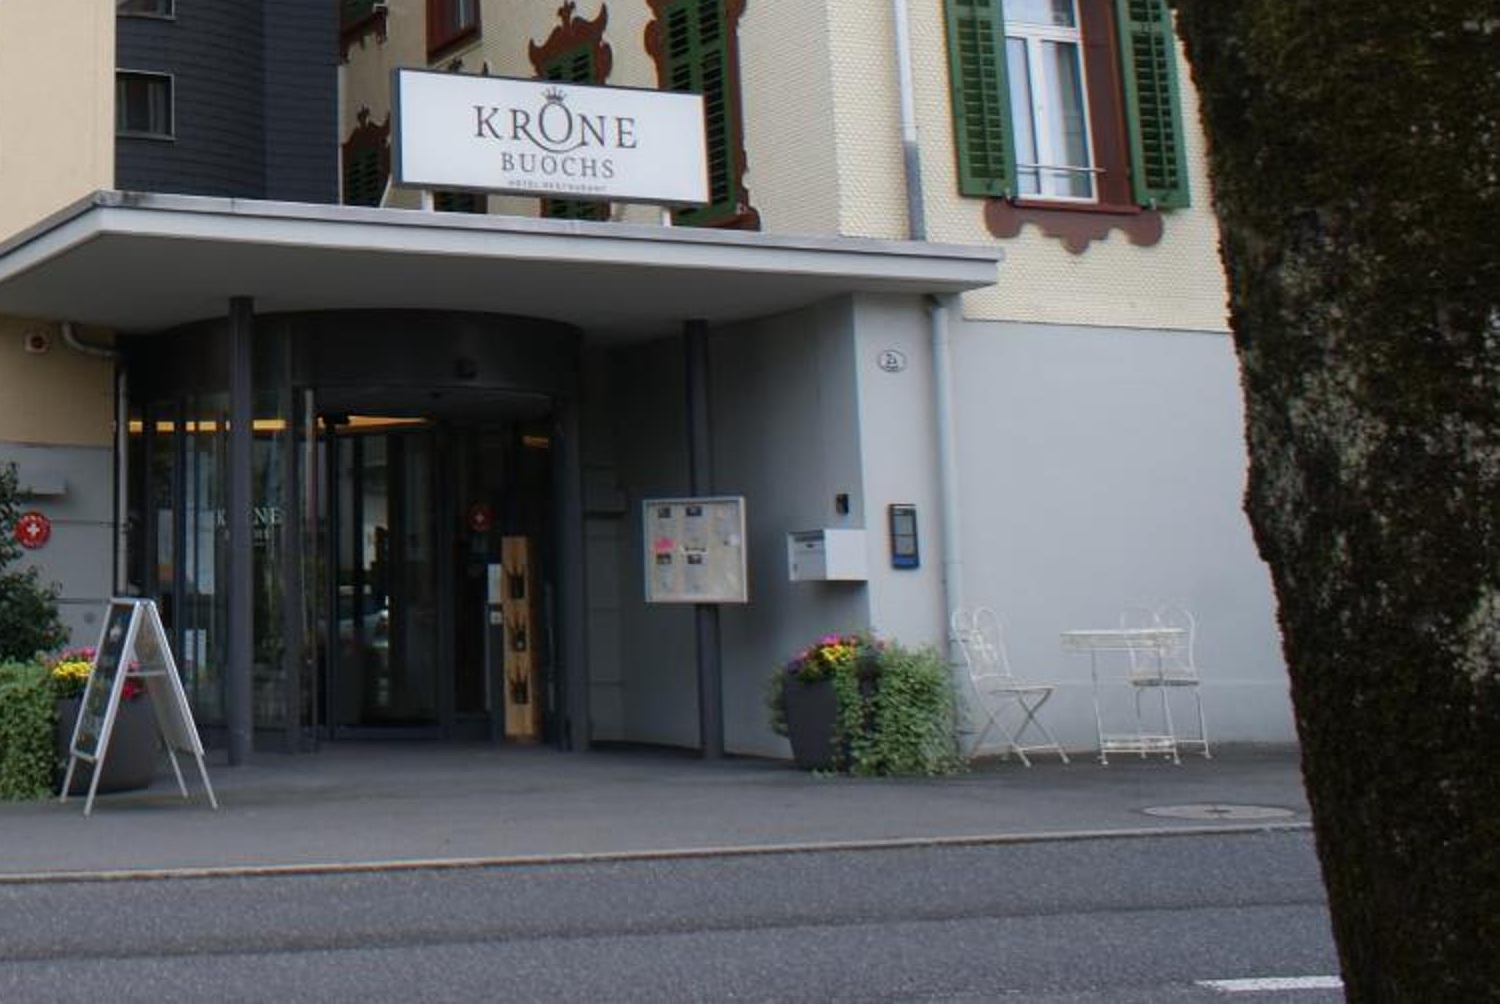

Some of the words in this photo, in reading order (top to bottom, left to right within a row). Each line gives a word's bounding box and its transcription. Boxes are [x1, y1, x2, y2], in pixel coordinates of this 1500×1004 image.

[473, 101, 637, 153] KRONE
[501, 152, 615, 179] BUOCHS
[217, 507, 282, 525] KNE
